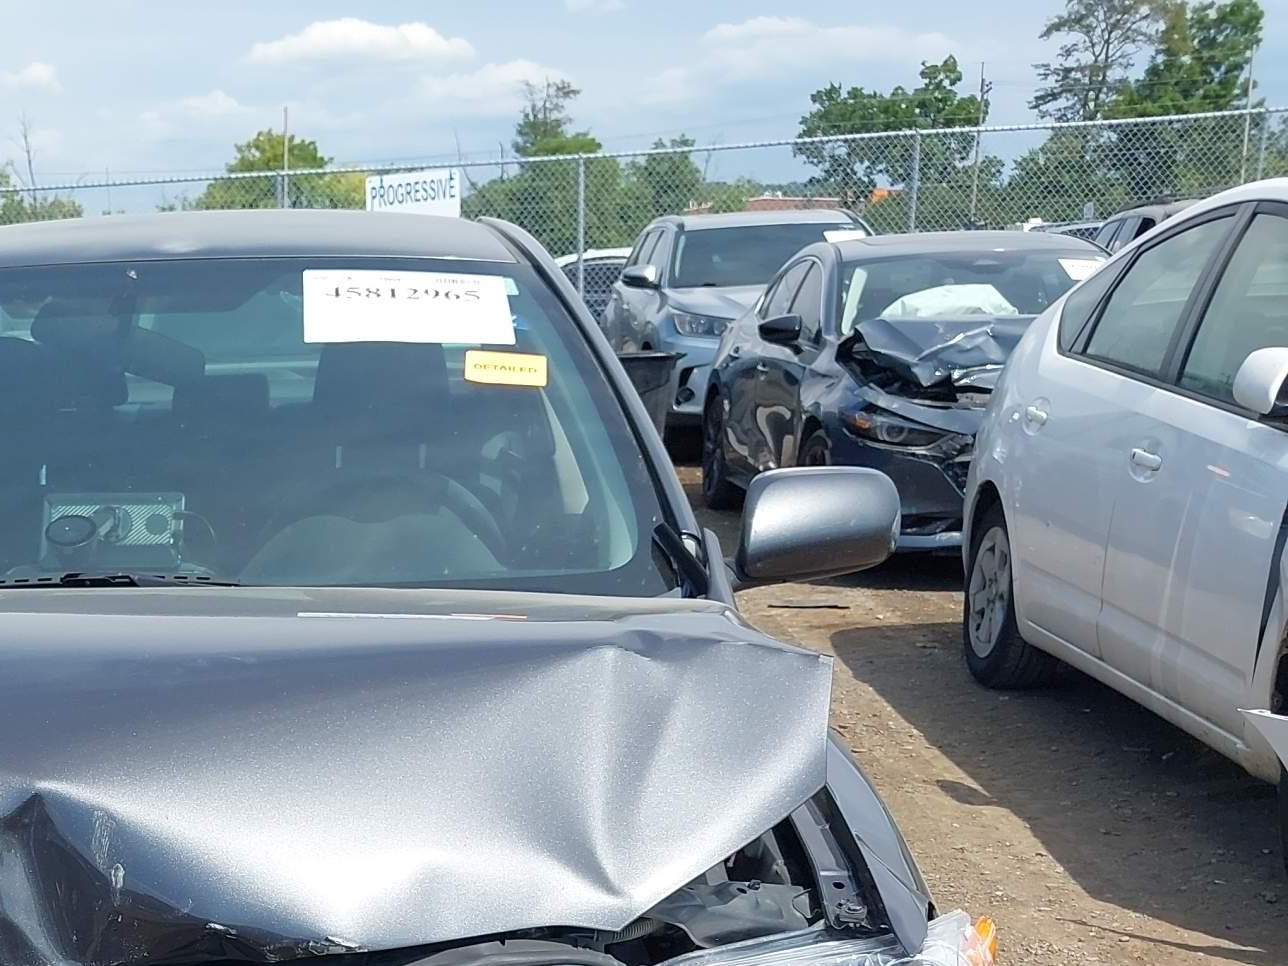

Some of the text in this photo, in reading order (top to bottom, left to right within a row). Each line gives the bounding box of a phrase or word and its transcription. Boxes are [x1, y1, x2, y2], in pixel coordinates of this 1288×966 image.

[370, 176, 456, 211] PROGRESSIVE
[325, 286, 481, 301] 45812965
[473, 362, 538, 374] DETAILED
